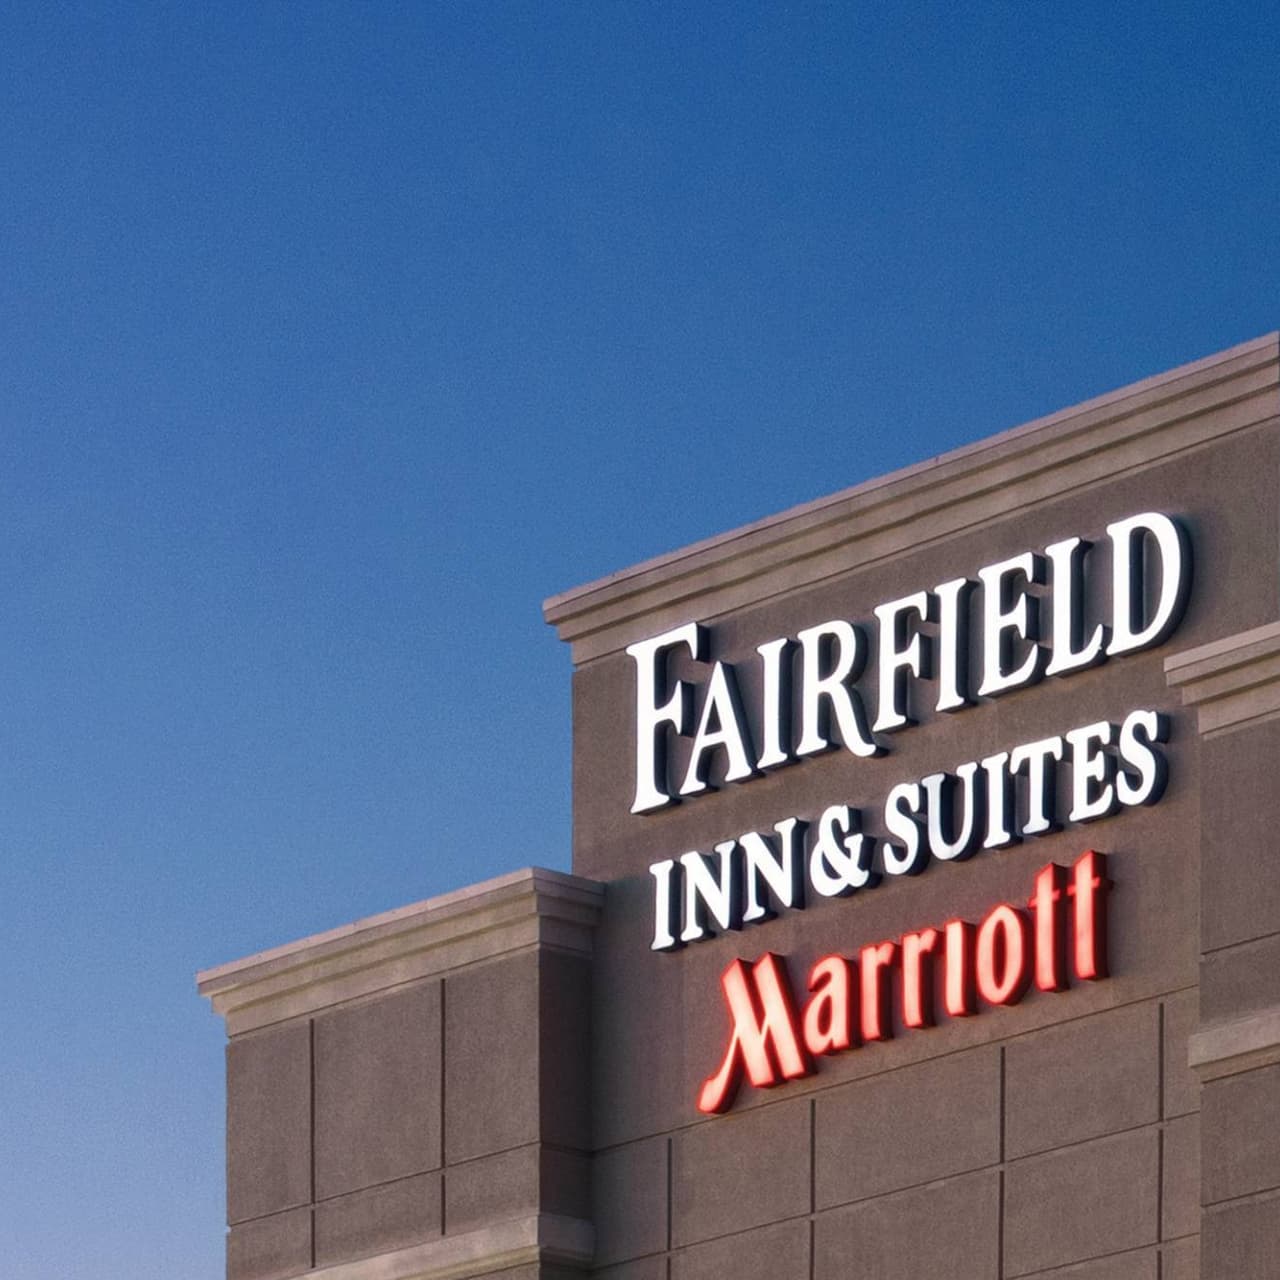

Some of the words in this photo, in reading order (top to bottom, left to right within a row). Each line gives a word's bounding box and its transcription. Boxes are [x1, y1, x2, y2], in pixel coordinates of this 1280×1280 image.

[624, 510, 1186, 816] FAIRFIELD
[648, 816, 804, 951] INN
[808, 803, 874, 898] &
[882, 708, 1166, 876] SUITES
[694, 847, 1110, 1115] Marriott
